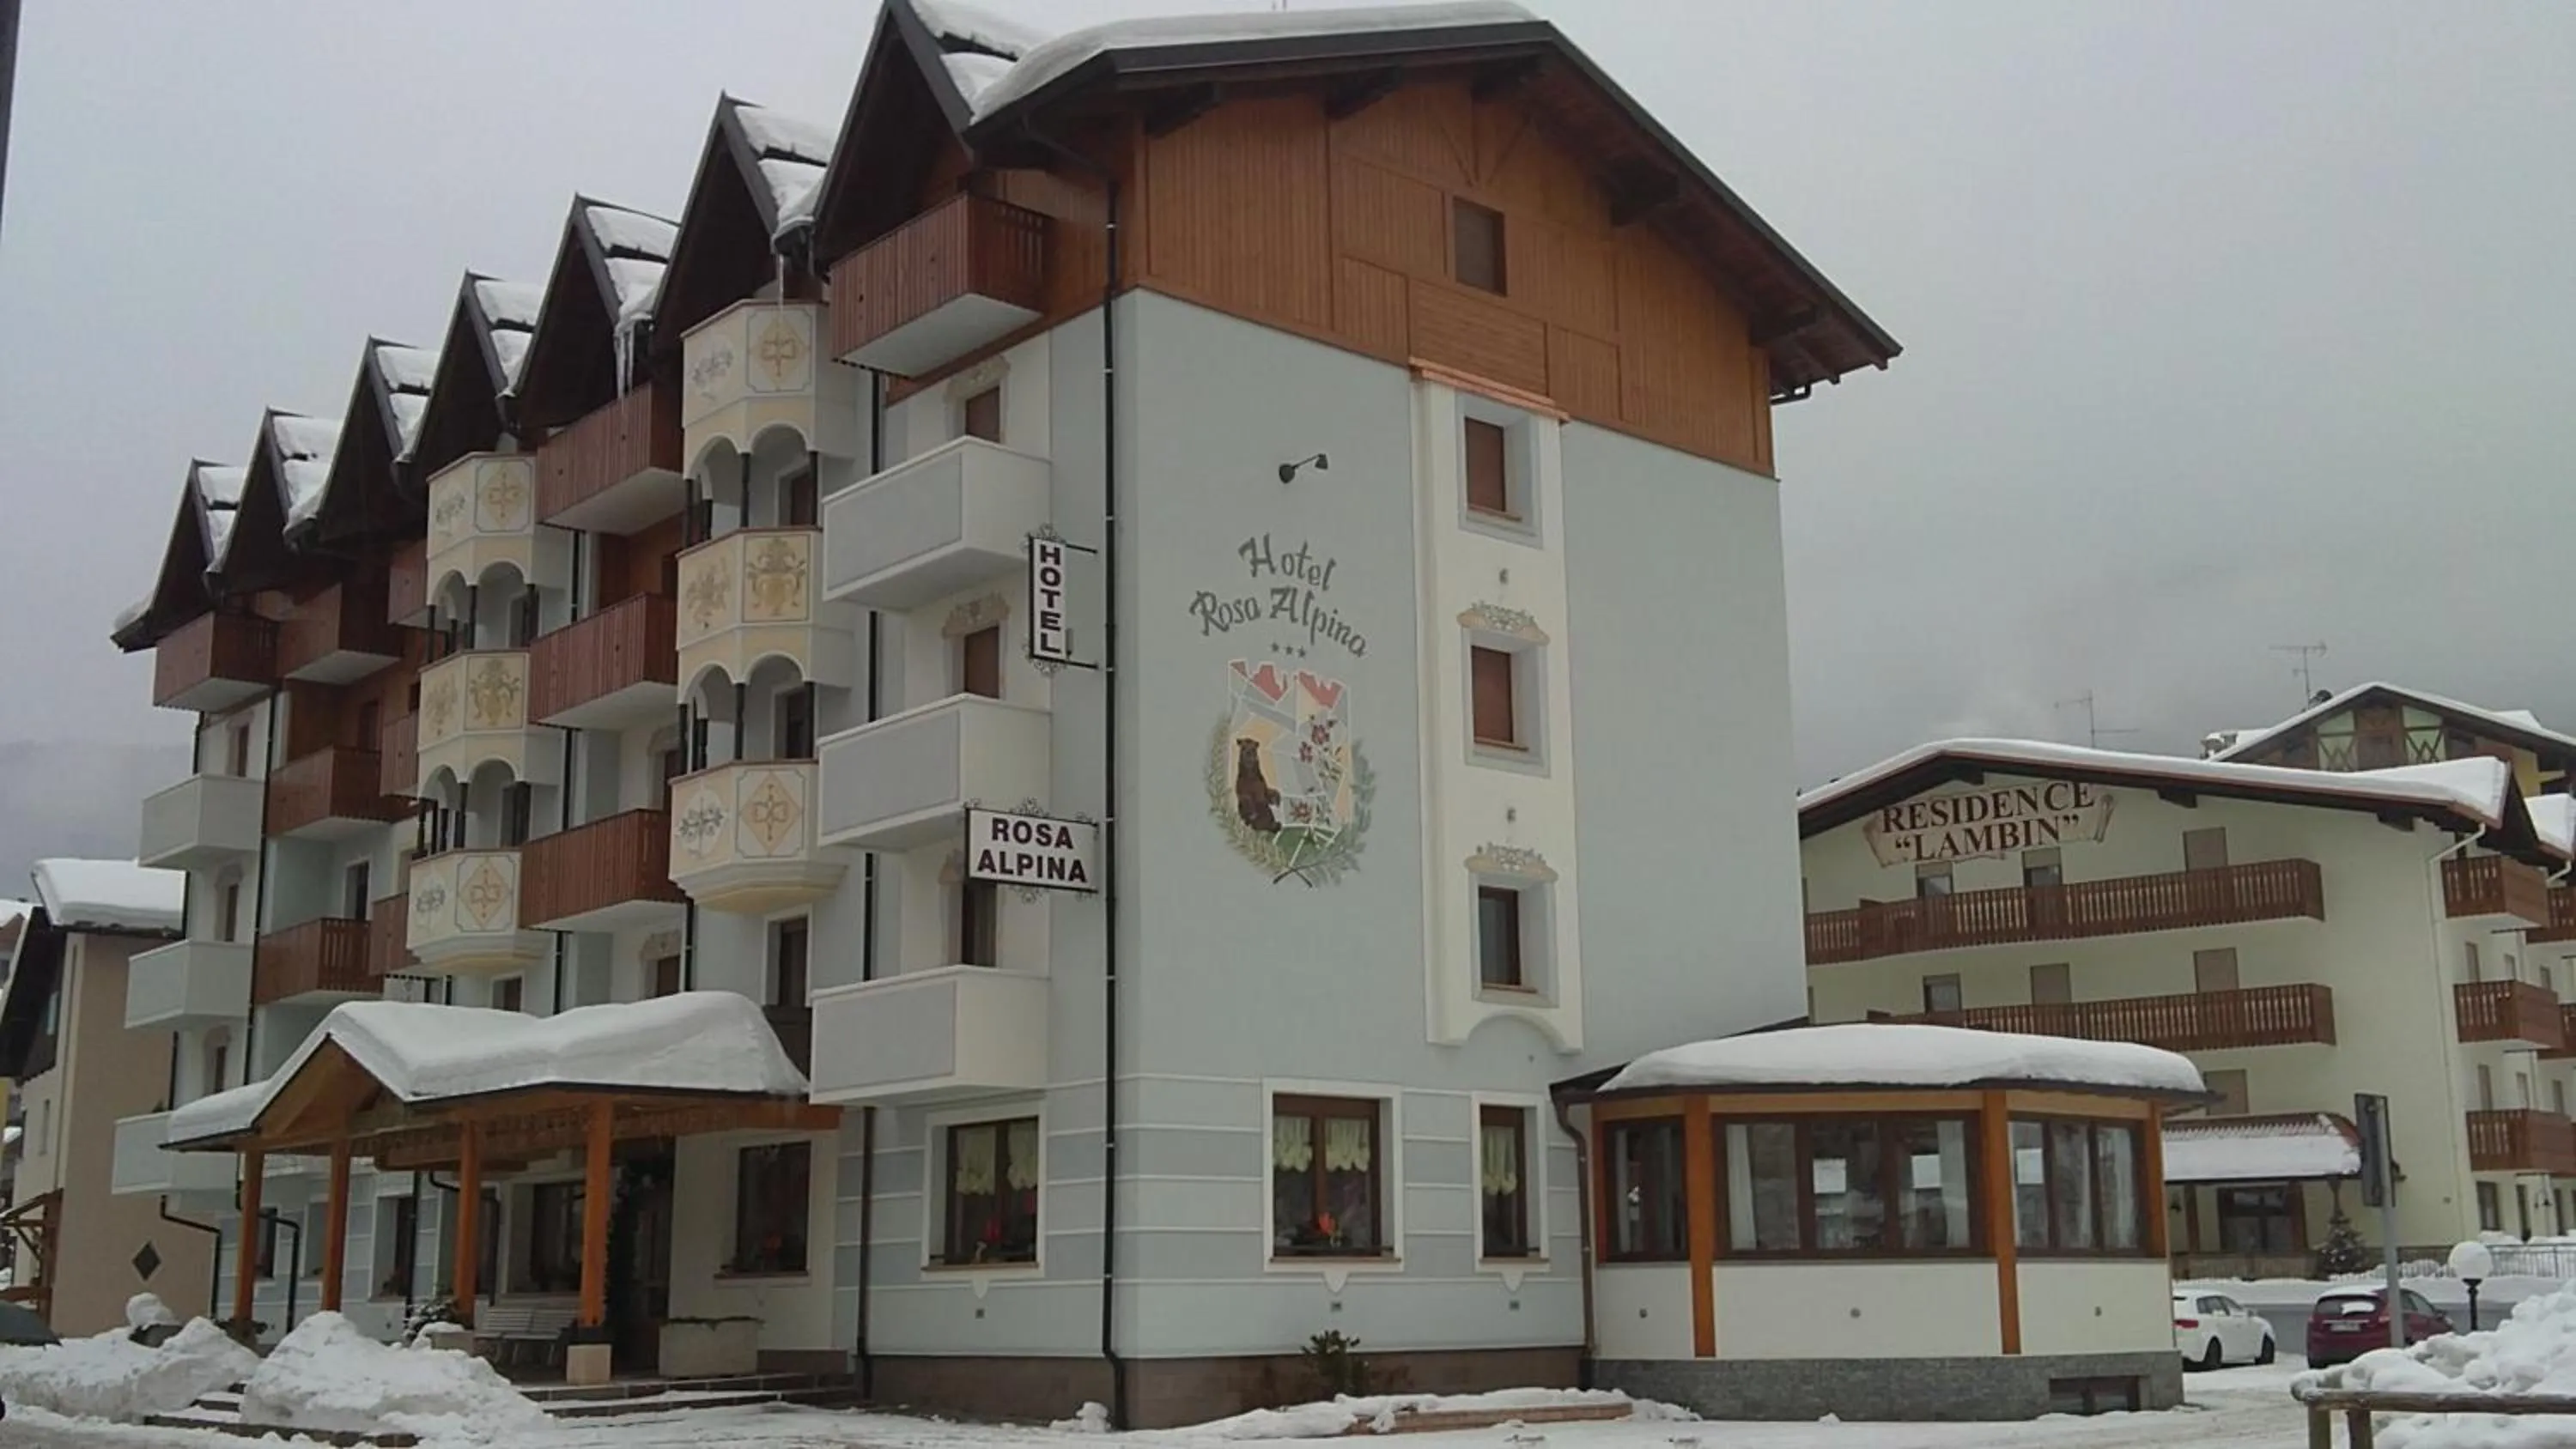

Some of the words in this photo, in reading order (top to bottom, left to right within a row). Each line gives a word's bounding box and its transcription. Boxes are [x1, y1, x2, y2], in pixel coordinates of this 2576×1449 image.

[1238, 533, 1336, 591] Hotel
[1039, 544, 1061, 654] HOTEL
[1189, 590, 1261, 636] Rosa
[1269, 586, 1367, 658] Alpina
[991, 817, 1073, 849] ROSA
[1881, 781, 2094, 833] RESIDENCE
[977, 849, 1087, 883] ALPINA
